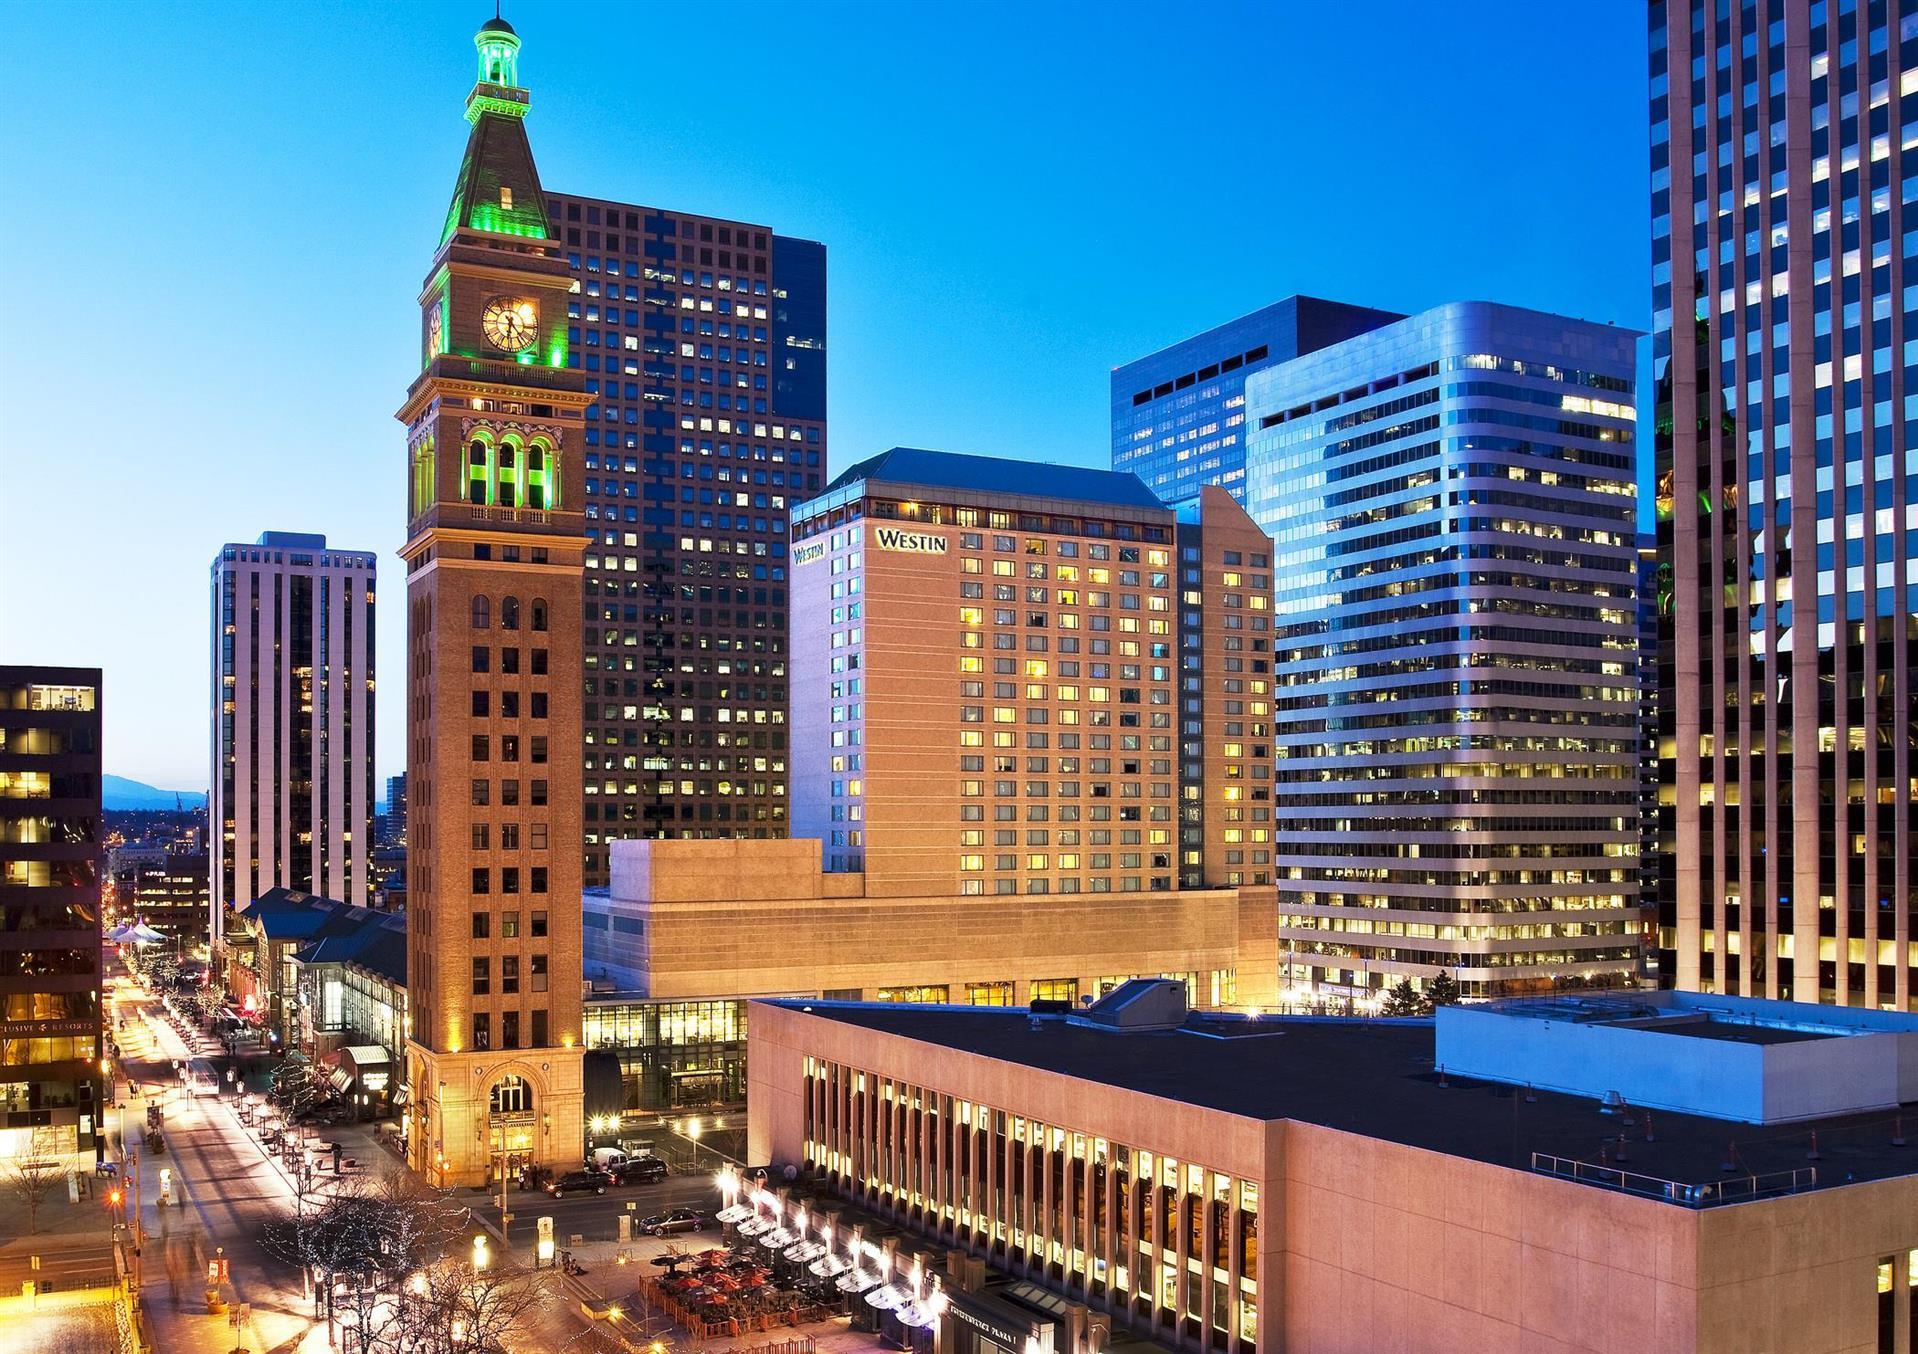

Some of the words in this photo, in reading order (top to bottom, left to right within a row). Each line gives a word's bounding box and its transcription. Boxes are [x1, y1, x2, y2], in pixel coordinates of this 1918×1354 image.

[878, 528, 946, 551] WESTIN
[793, 542, 824, 565] WESTIN
[0, 1023, 34, 1033] LUSIVE
